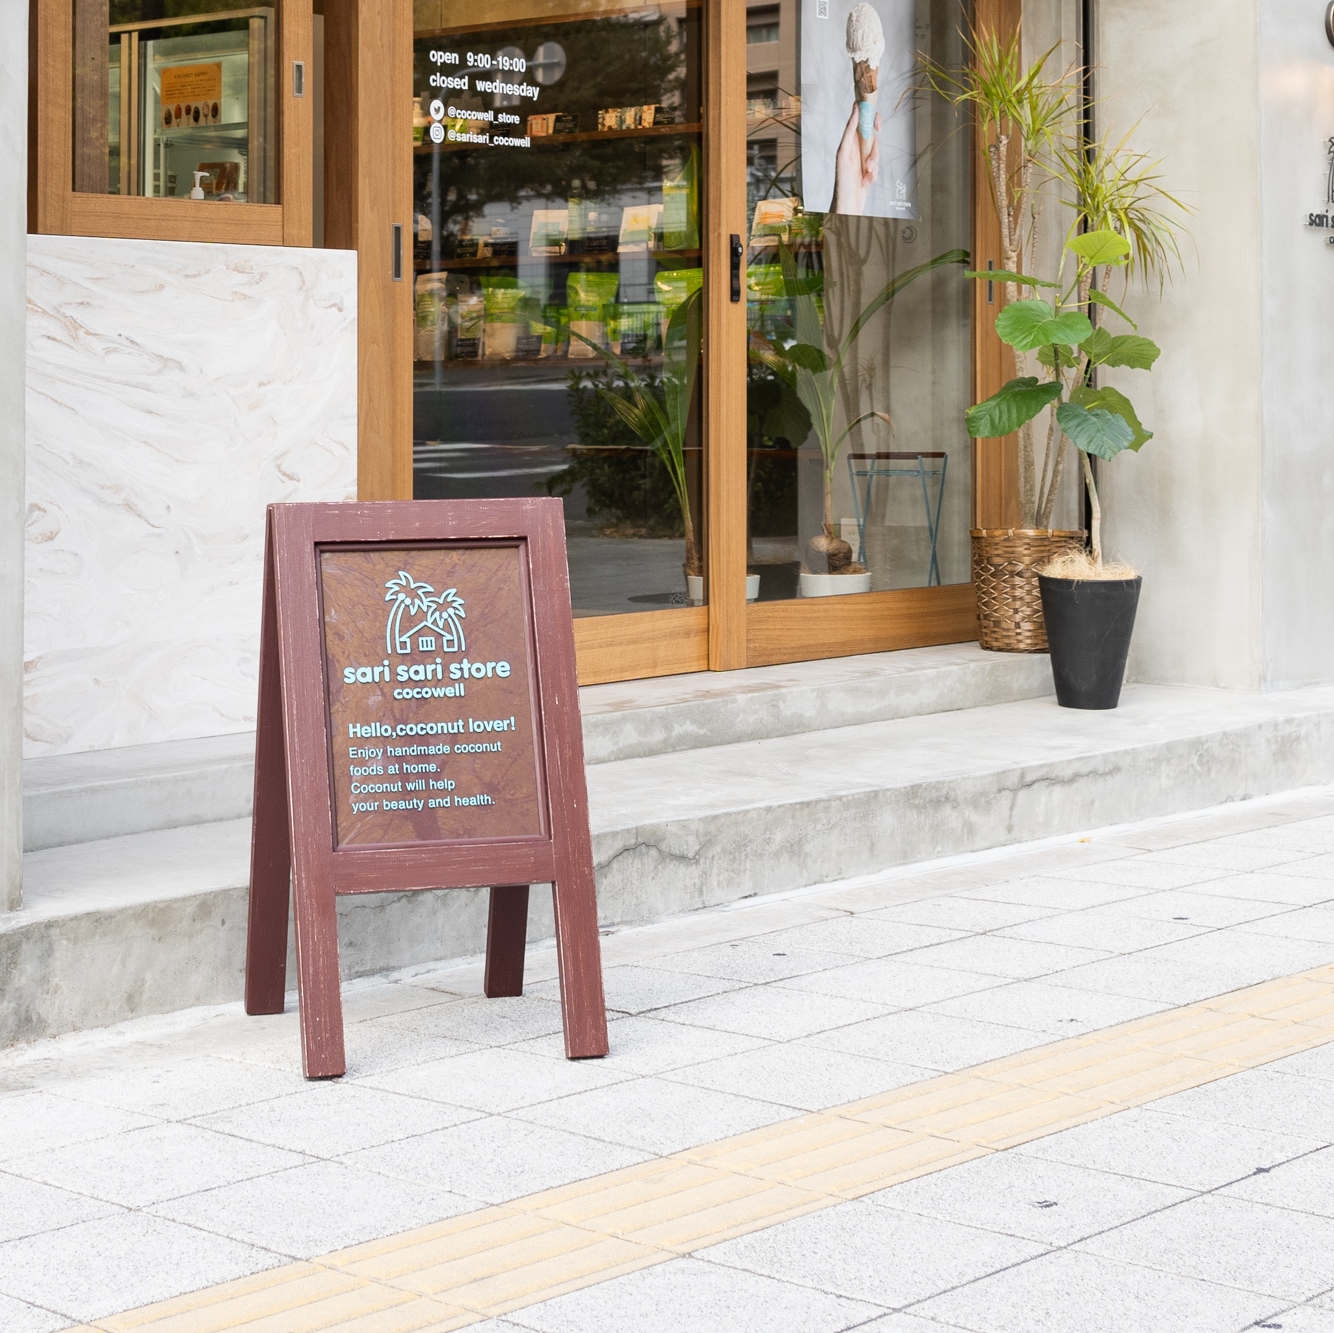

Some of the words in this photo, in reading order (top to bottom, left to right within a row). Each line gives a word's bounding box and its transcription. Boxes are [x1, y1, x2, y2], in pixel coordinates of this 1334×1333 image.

[429, 50, 459, 66] open
[466, 52, 526, 72] 9:00-19:00
[429, 72, 469, 90] closed
[475, 79, 540, 101] wednesday
[448, 106, 520, 124] @cocowell_store
[447, 129, 531, 148] @sarisari_cocowell
[1308, 209, 1329, 227] sari
[343, 659, 390, 684] sari
[396, 657, 443, 682] sari
[449, 658, 511, 680] store
[393, 682, 466, 700] cocowell
[468, 716, 516, 733] lover!
[348, 746, 384, 761] Enjoy
[386, 742, 451, 758] handmade
[453, 740, 503, 755] coconut
[349, 763, 385, 777] foods
[387, 763, 400, 775] at
[402, 761, 442, 774] home.
[350, 780, 403, 795] Coconut
[405, 779, 426, 792] will
[428, 778, 457, 792] help
[351, 800, 380, 815] your
[382, 796, 425, 812] beauty
[427, 795, 452, 808] and
[453, 793, 497, 807] health.
